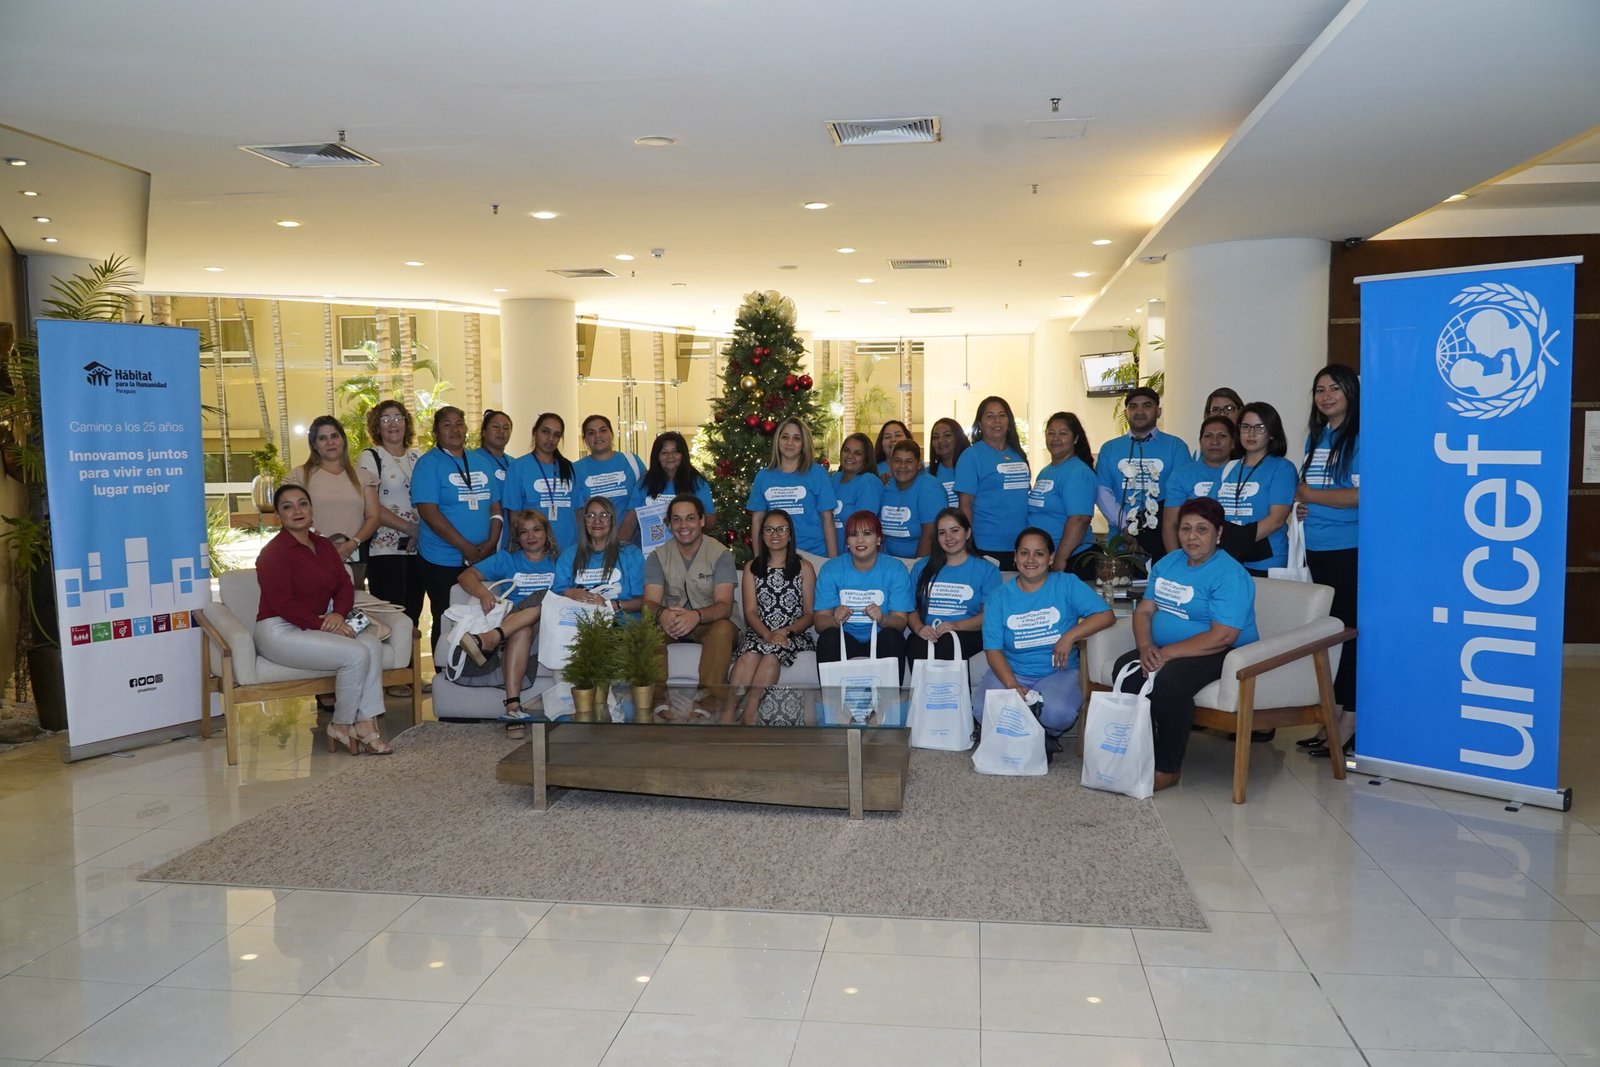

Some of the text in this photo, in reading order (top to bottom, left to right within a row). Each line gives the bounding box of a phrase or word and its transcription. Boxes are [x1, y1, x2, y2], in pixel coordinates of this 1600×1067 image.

[115, 369, 152, 381] Hábitat
[70, 422, 184, 432] Camino a los 25 años
[69, 449, 188, 461] Innovamos juntos
[79, 466, 183, 480] para vivir en un
[93, 483, 170, 497] lugar mejor
[1432, 432, 1542, 771] unicef
